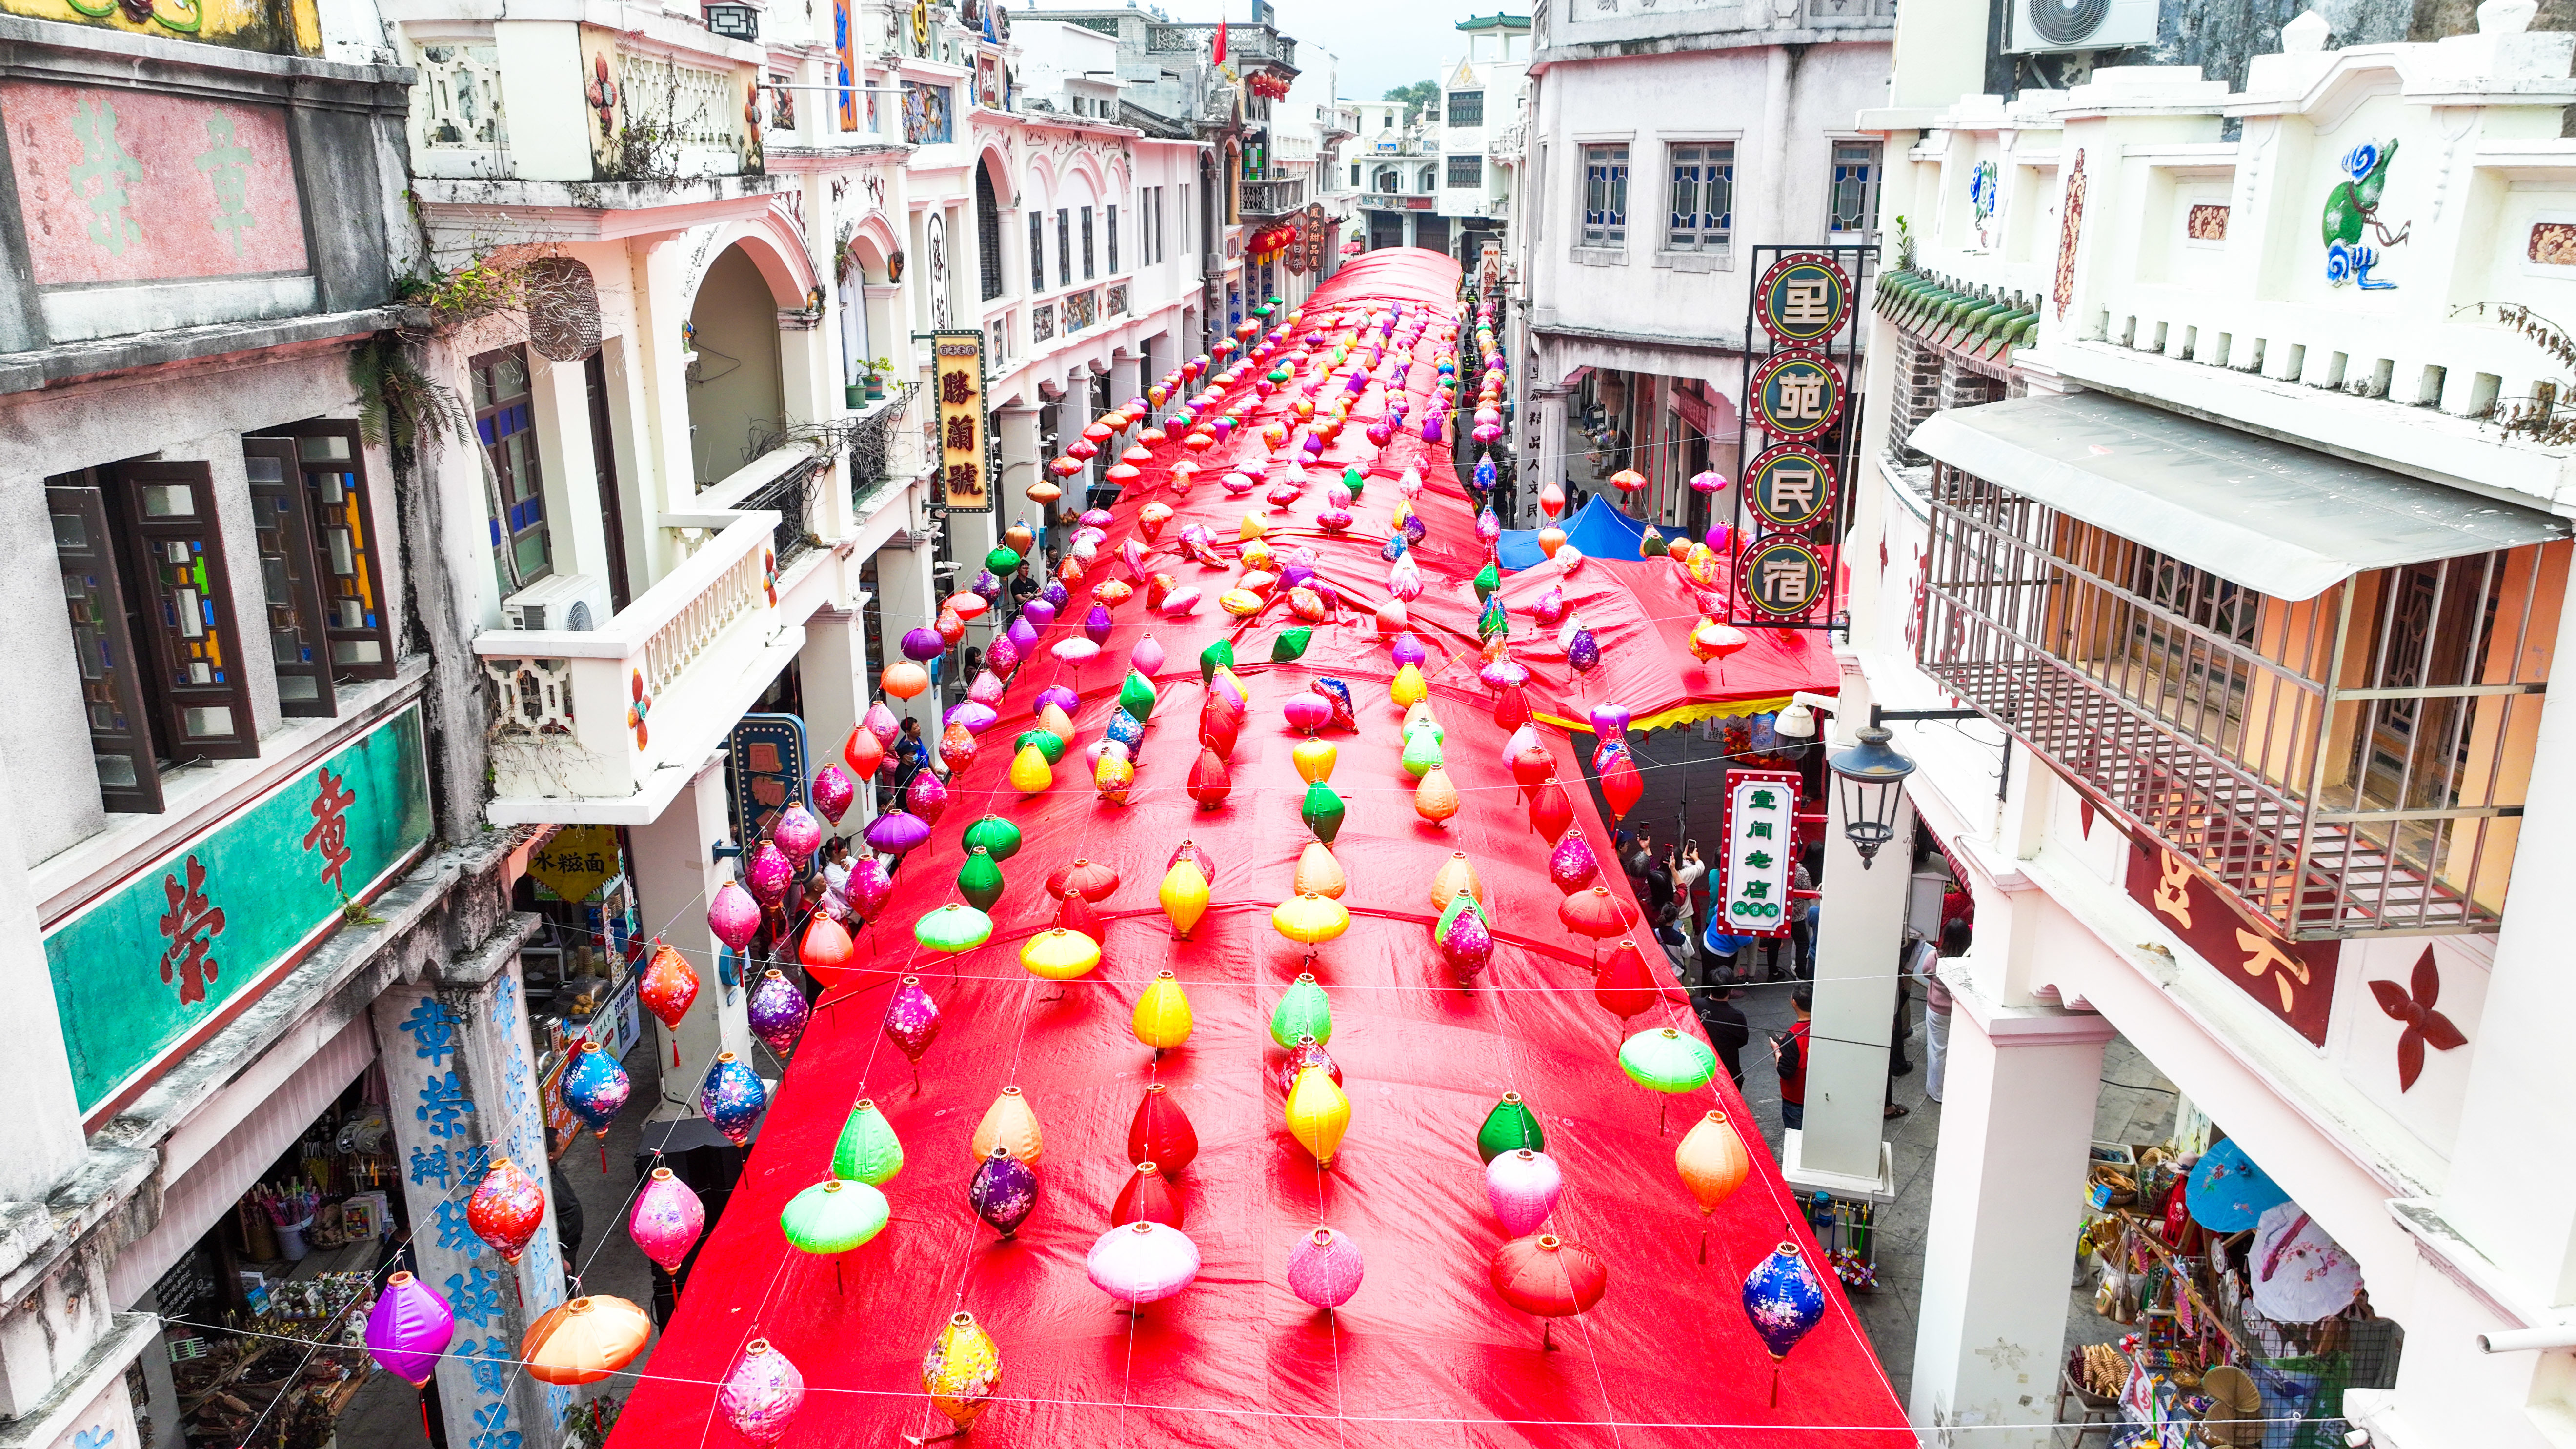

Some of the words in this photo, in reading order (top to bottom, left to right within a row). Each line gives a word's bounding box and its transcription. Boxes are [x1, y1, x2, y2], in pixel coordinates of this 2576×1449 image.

[1309, 207, 1321, 267] 鳳秀甜品屋
[940, 346, 974, 355] 百年老店
[942, 368, 983, 495] 勝蘭號
[1762, 277, 1830, 603] 里苑民宿
[1733, 904, 1778, 917] 租售馆
[614, 982, 635, 1016] 竹筒奶茶
